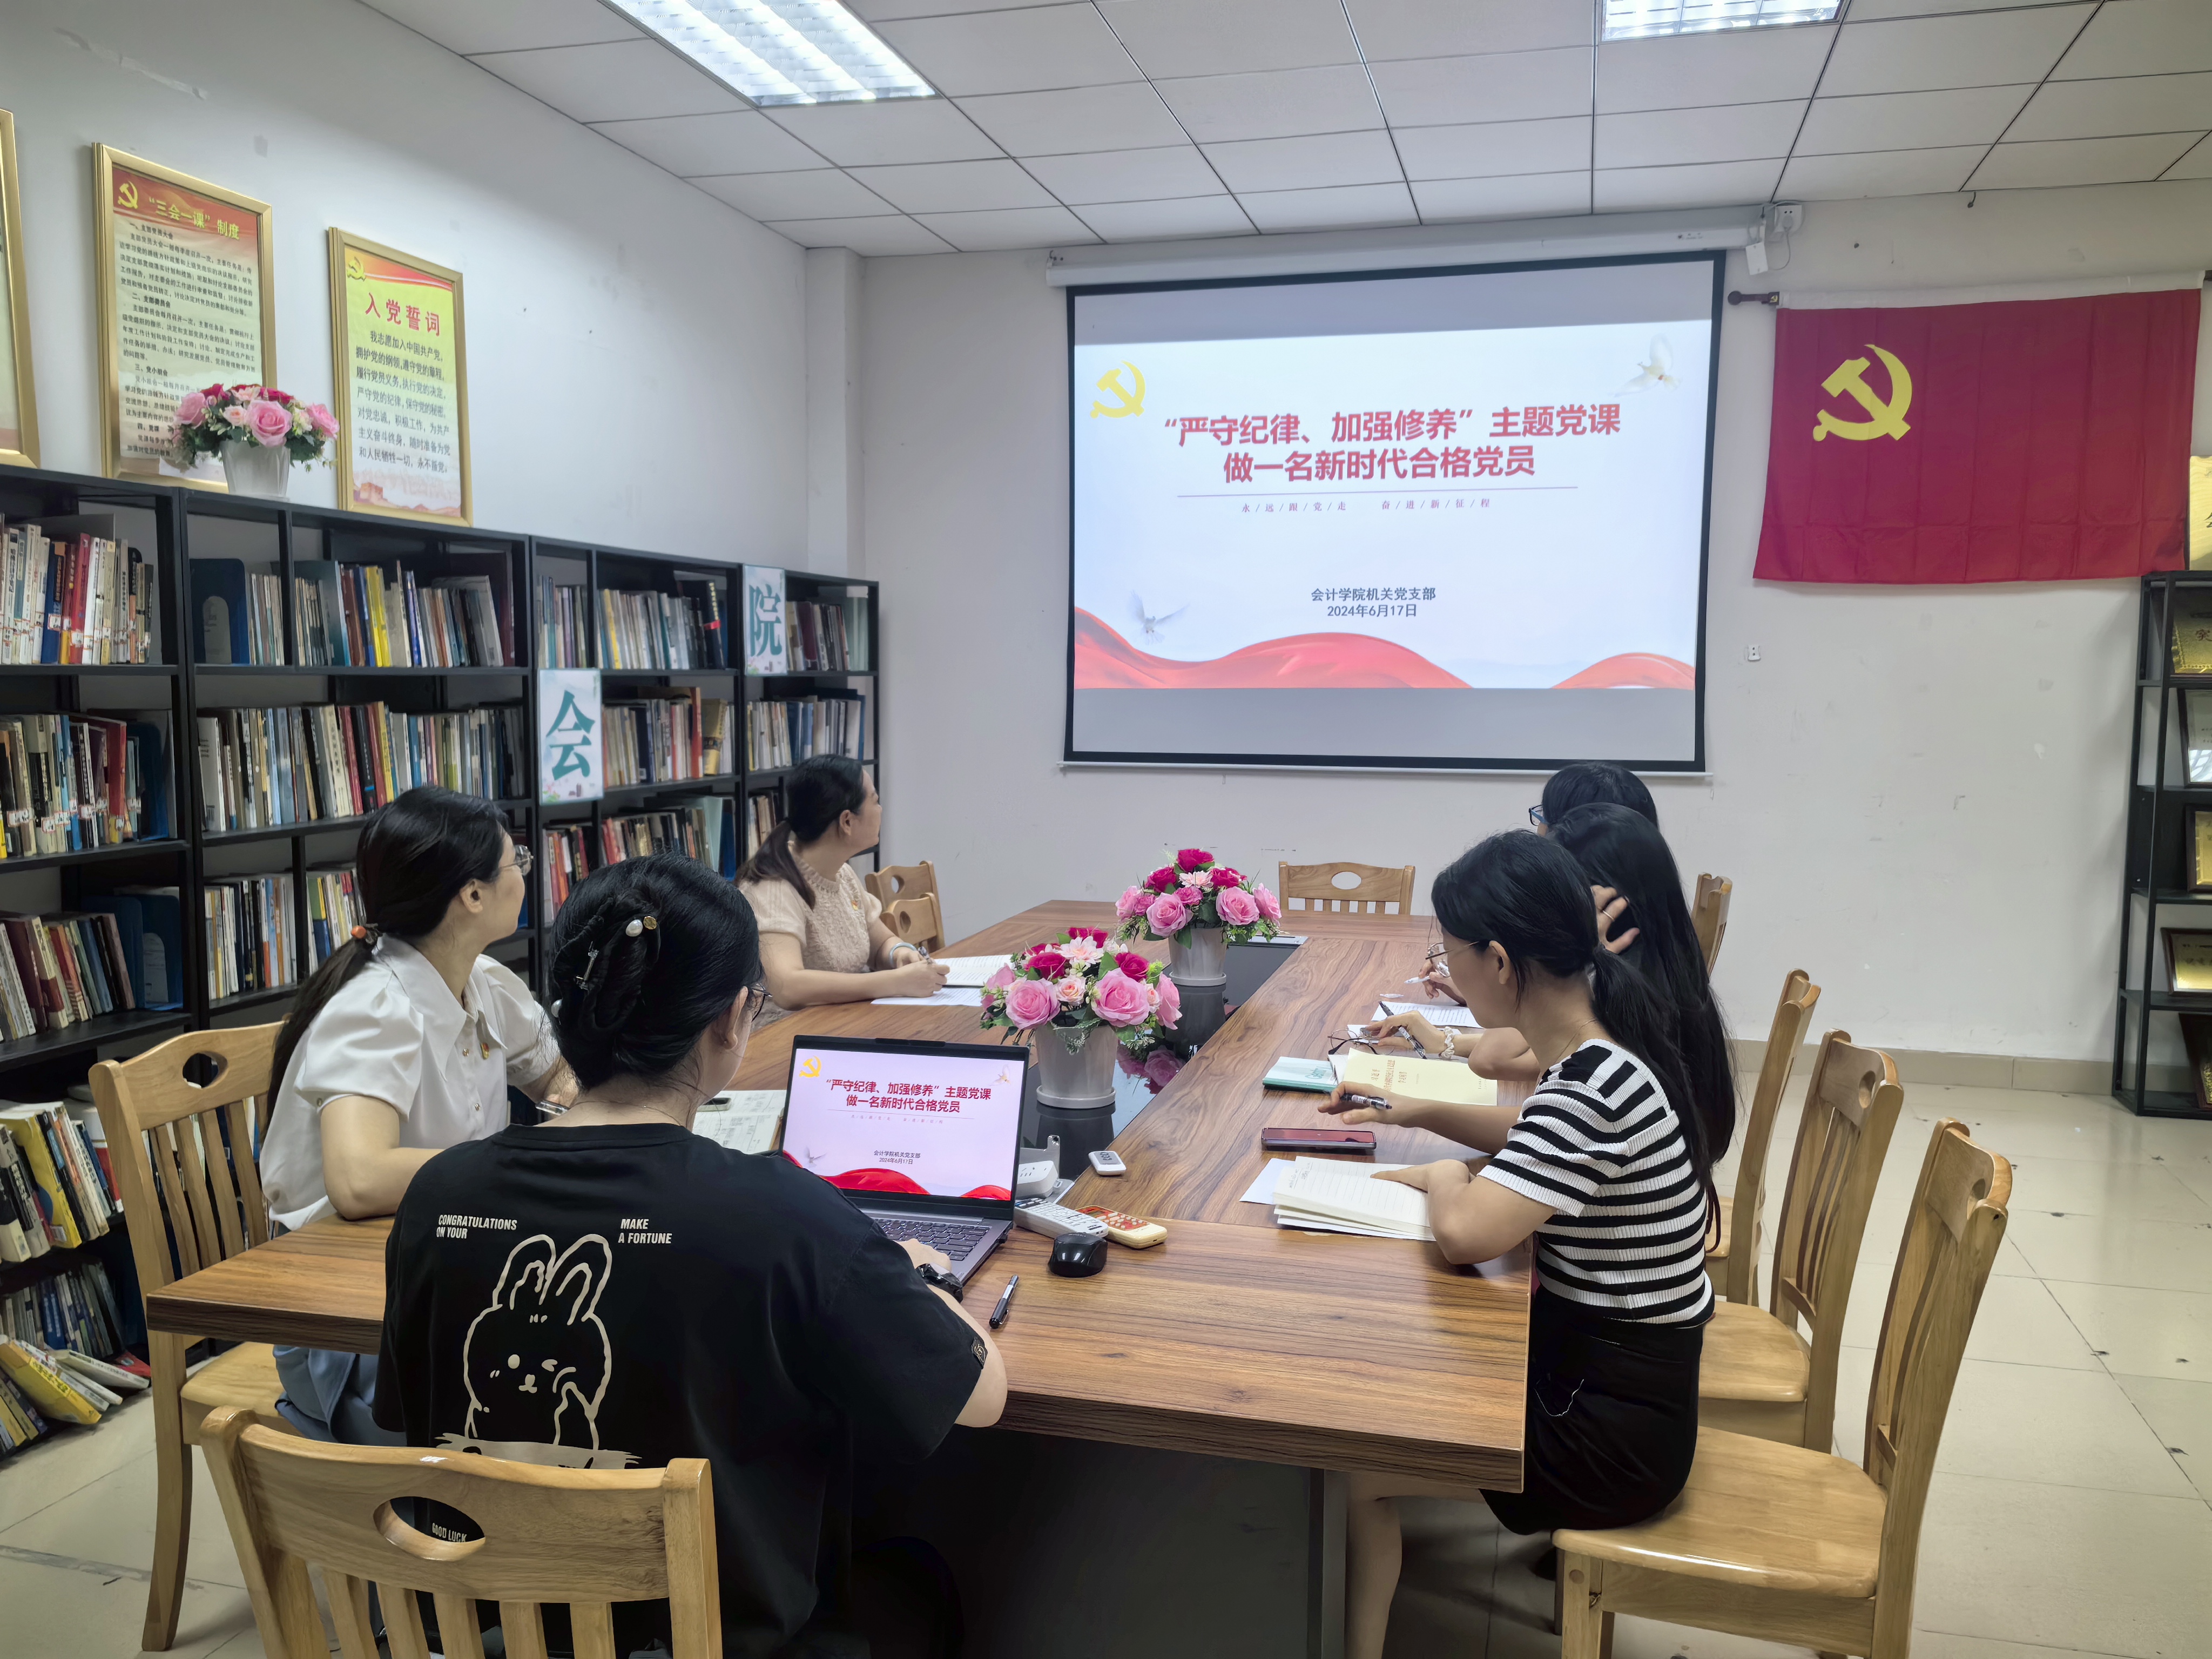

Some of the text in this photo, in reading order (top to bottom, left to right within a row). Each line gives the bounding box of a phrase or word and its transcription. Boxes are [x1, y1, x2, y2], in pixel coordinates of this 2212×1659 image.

[365, 292, 440, 336] 入党誓词
[1223, 445, 1536, 483] 做一名新时代合格党员
[1311, 586, 1436, 602] 会计学院机关党支部
[1327, 604, 1417, 617] 2024年6月17日
[748, 584, 783, 657] 院
[545, 689, 596, 781] 会
[846, 1095, 961, 1113] 做一名新时代合格党员
[874, 1150, 921, 1158] 会计学院机关党支部
[439, 1214, 518, 1230] CONGRATULATIONS
[621, 1218, 649, 1230] MAKE
[436, 1226, 468, 1239] ON YOUR
[618, 1232, 672, 1244] A FORTUNE
[432, 1522, 467, 1542] GOOD LUCK
